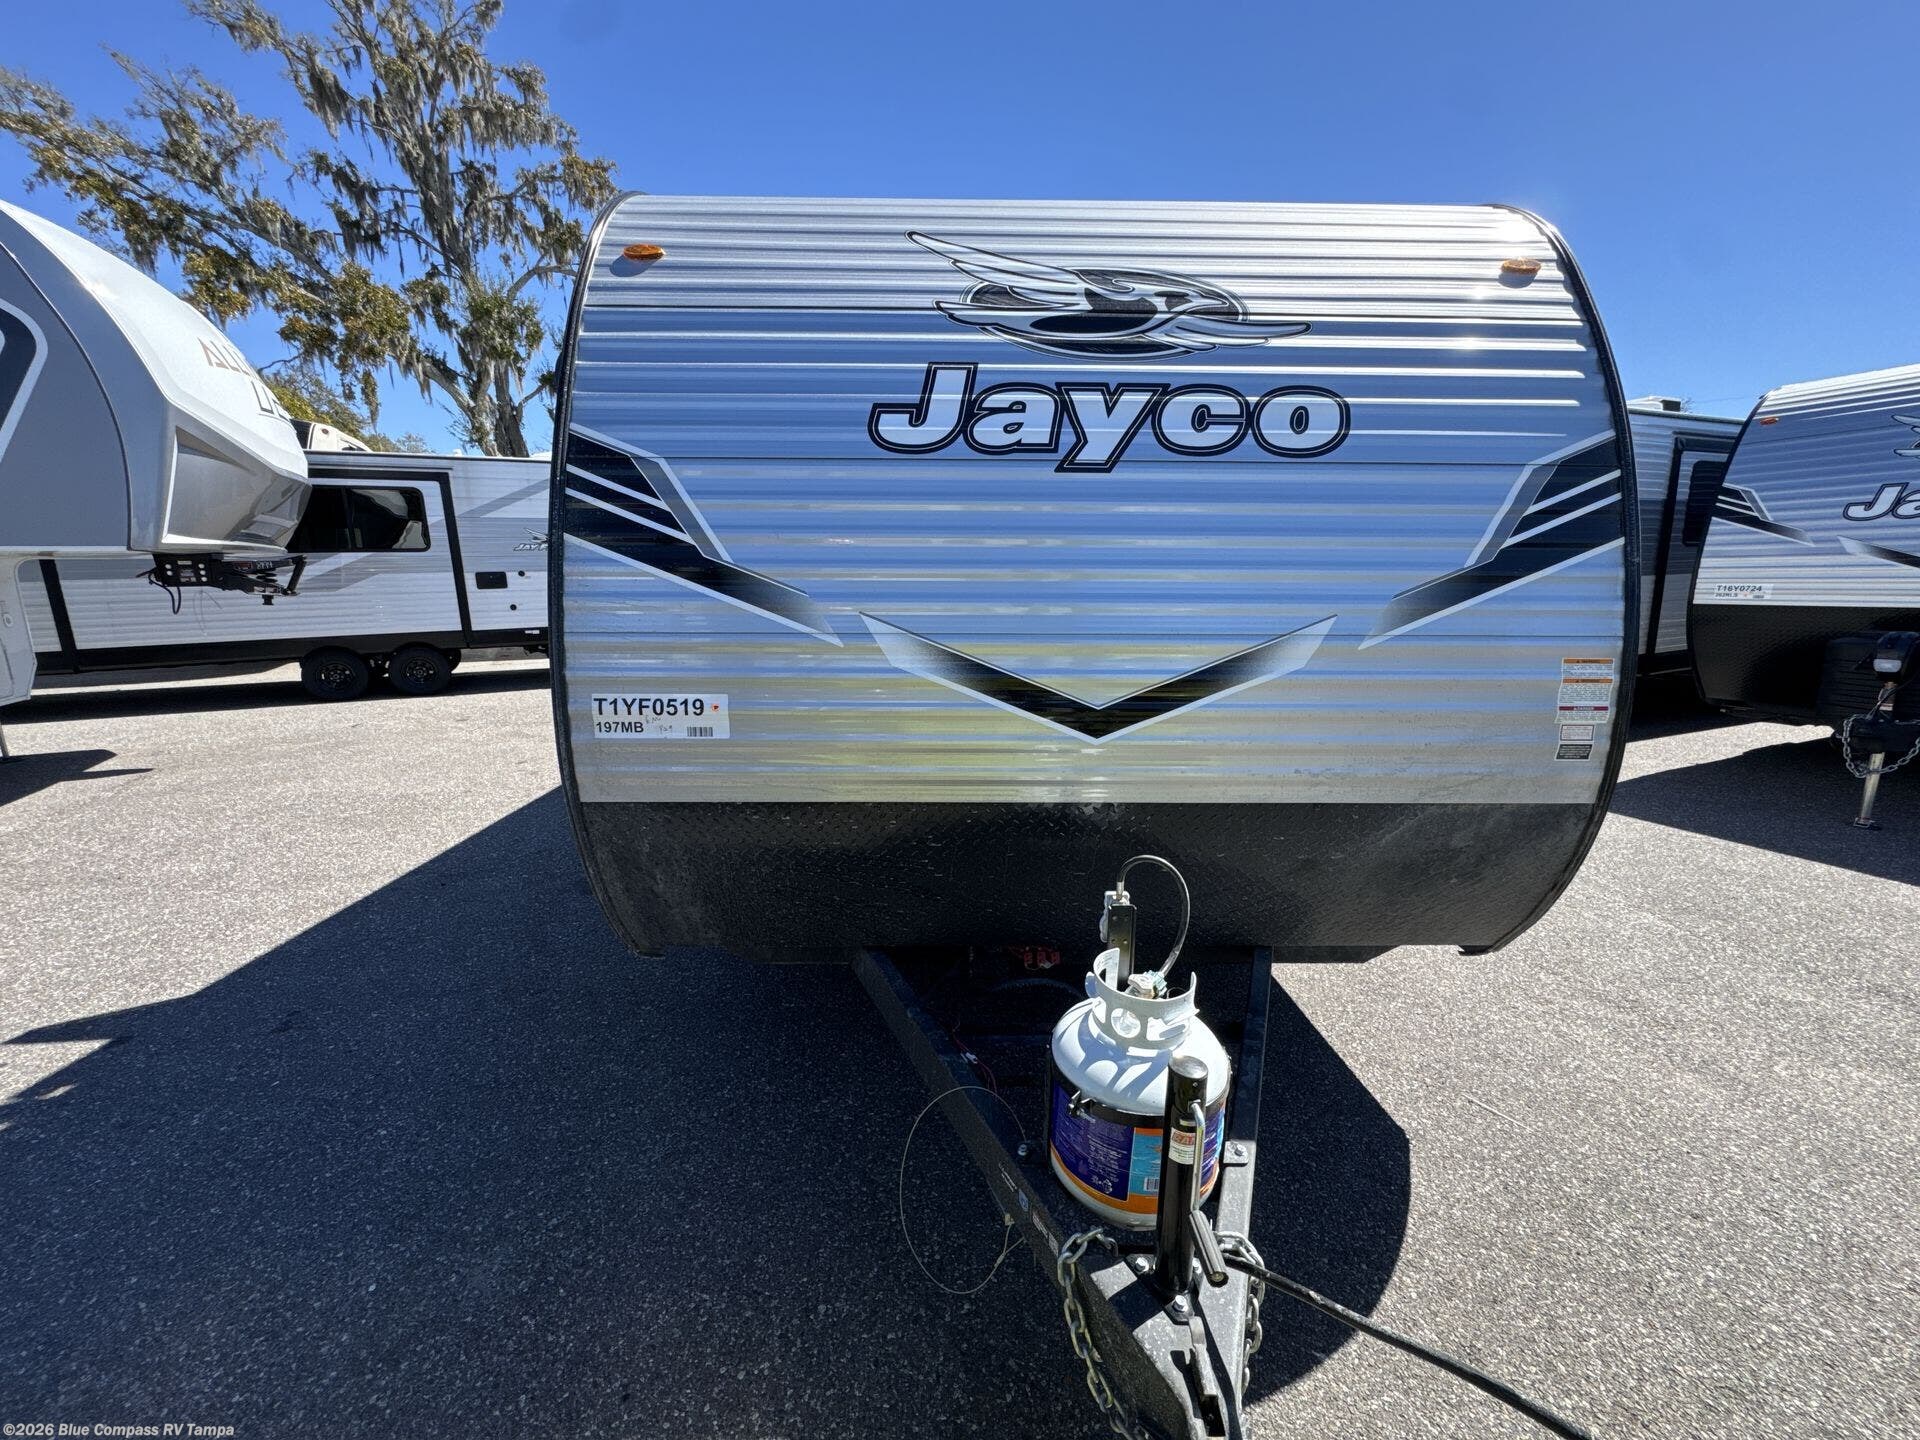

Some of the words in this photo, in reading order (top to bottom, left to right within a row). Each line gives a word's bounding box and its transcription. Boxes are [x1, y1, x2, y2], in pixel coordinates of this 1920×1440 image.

[867, 361, 1351, 473] Jayco
[513, 543, 538, 551] JAY
[593, 698, 705, 716] T1YF0519
[596, 721, 644, 733] 197MB
